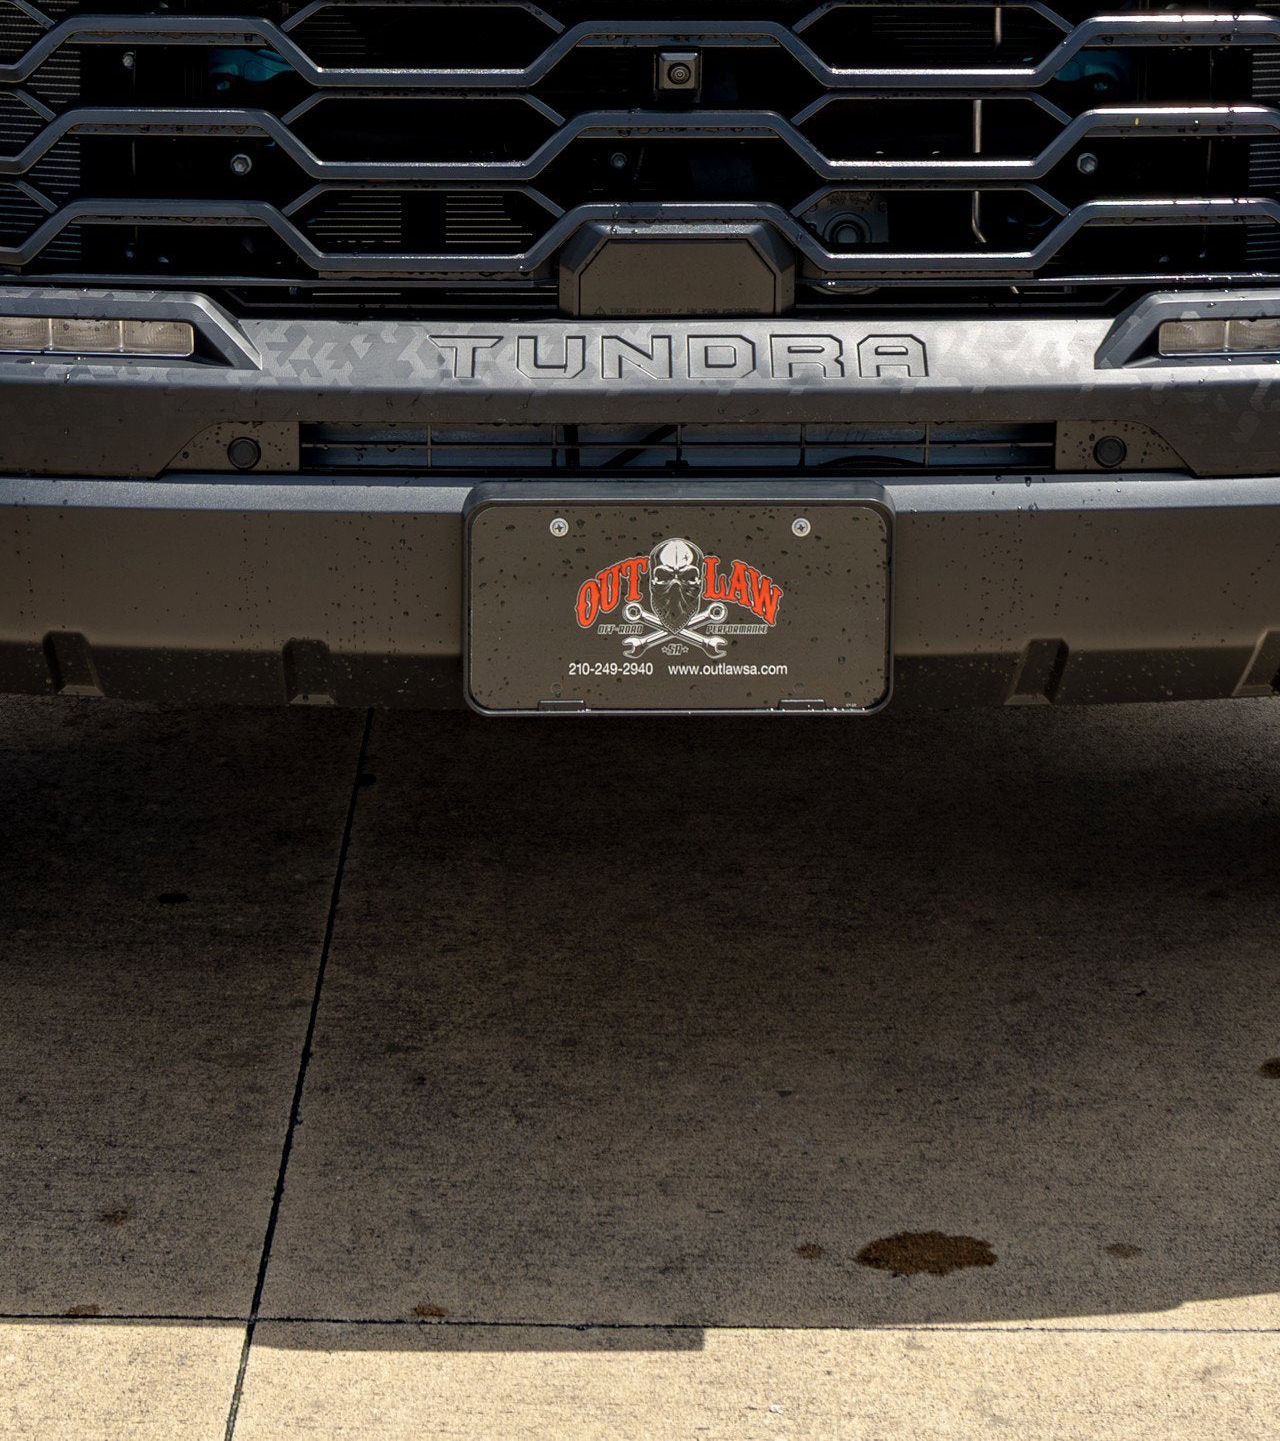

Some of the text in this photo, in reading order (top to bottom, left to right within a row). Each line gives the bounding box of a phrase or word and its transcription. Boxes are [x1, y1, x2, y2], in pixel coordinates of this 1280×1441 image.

[427, 334, 929, 380] TUNDRA
[597, 623, 769, 635] OFF-ROAD PERFORMANCE
[568, 663, 788, 676] 210-249-2940 www.outlawsa.com
